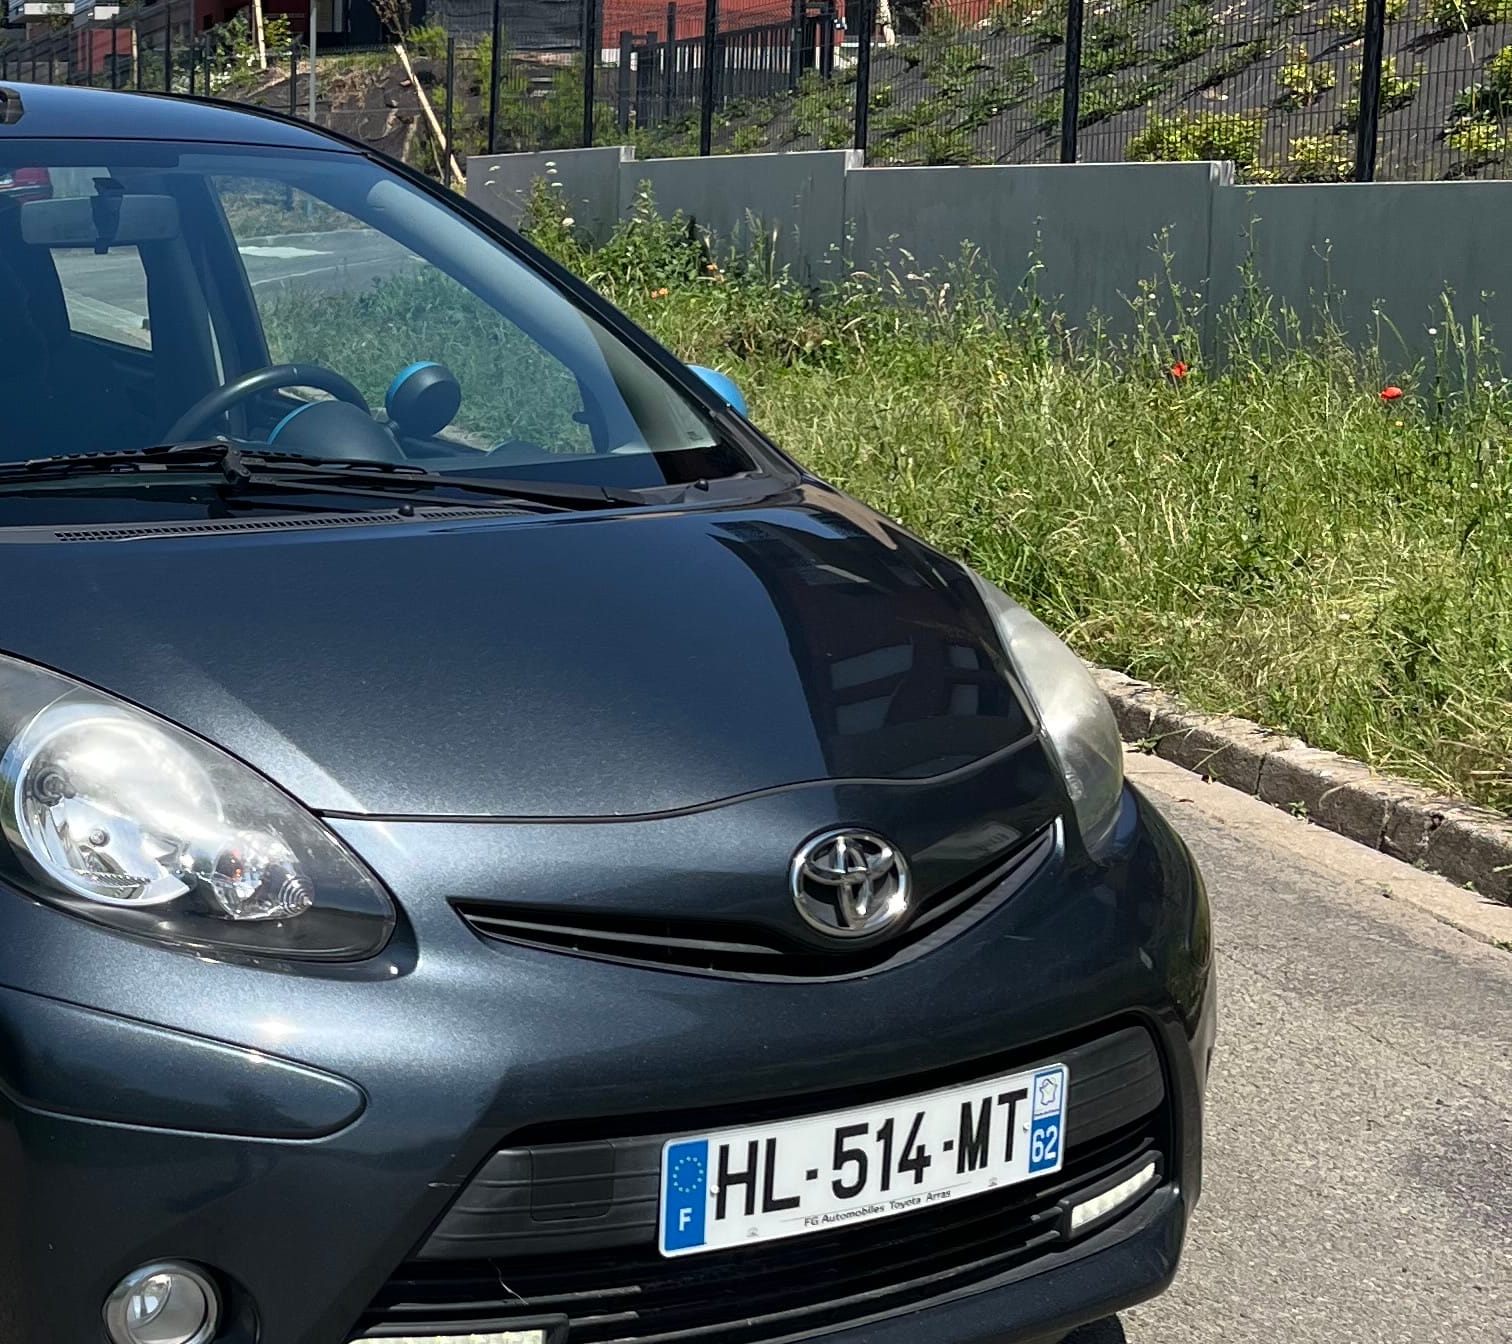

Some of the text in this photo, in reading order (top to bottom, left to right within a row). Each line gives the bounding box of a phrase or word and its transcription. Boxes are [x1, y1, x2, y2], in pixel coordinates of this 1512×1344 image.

[715, 1088, 1029, 1221] HL-514-MT
[1031, 1124, 1059, 1165] 62
[678, 1207, 693, 1232] F
[821, 1204, 885, 1224] Automobiles
[889, 1196, 922, 1211] Toyota
[925, 1190, 951, 1202] Arras
